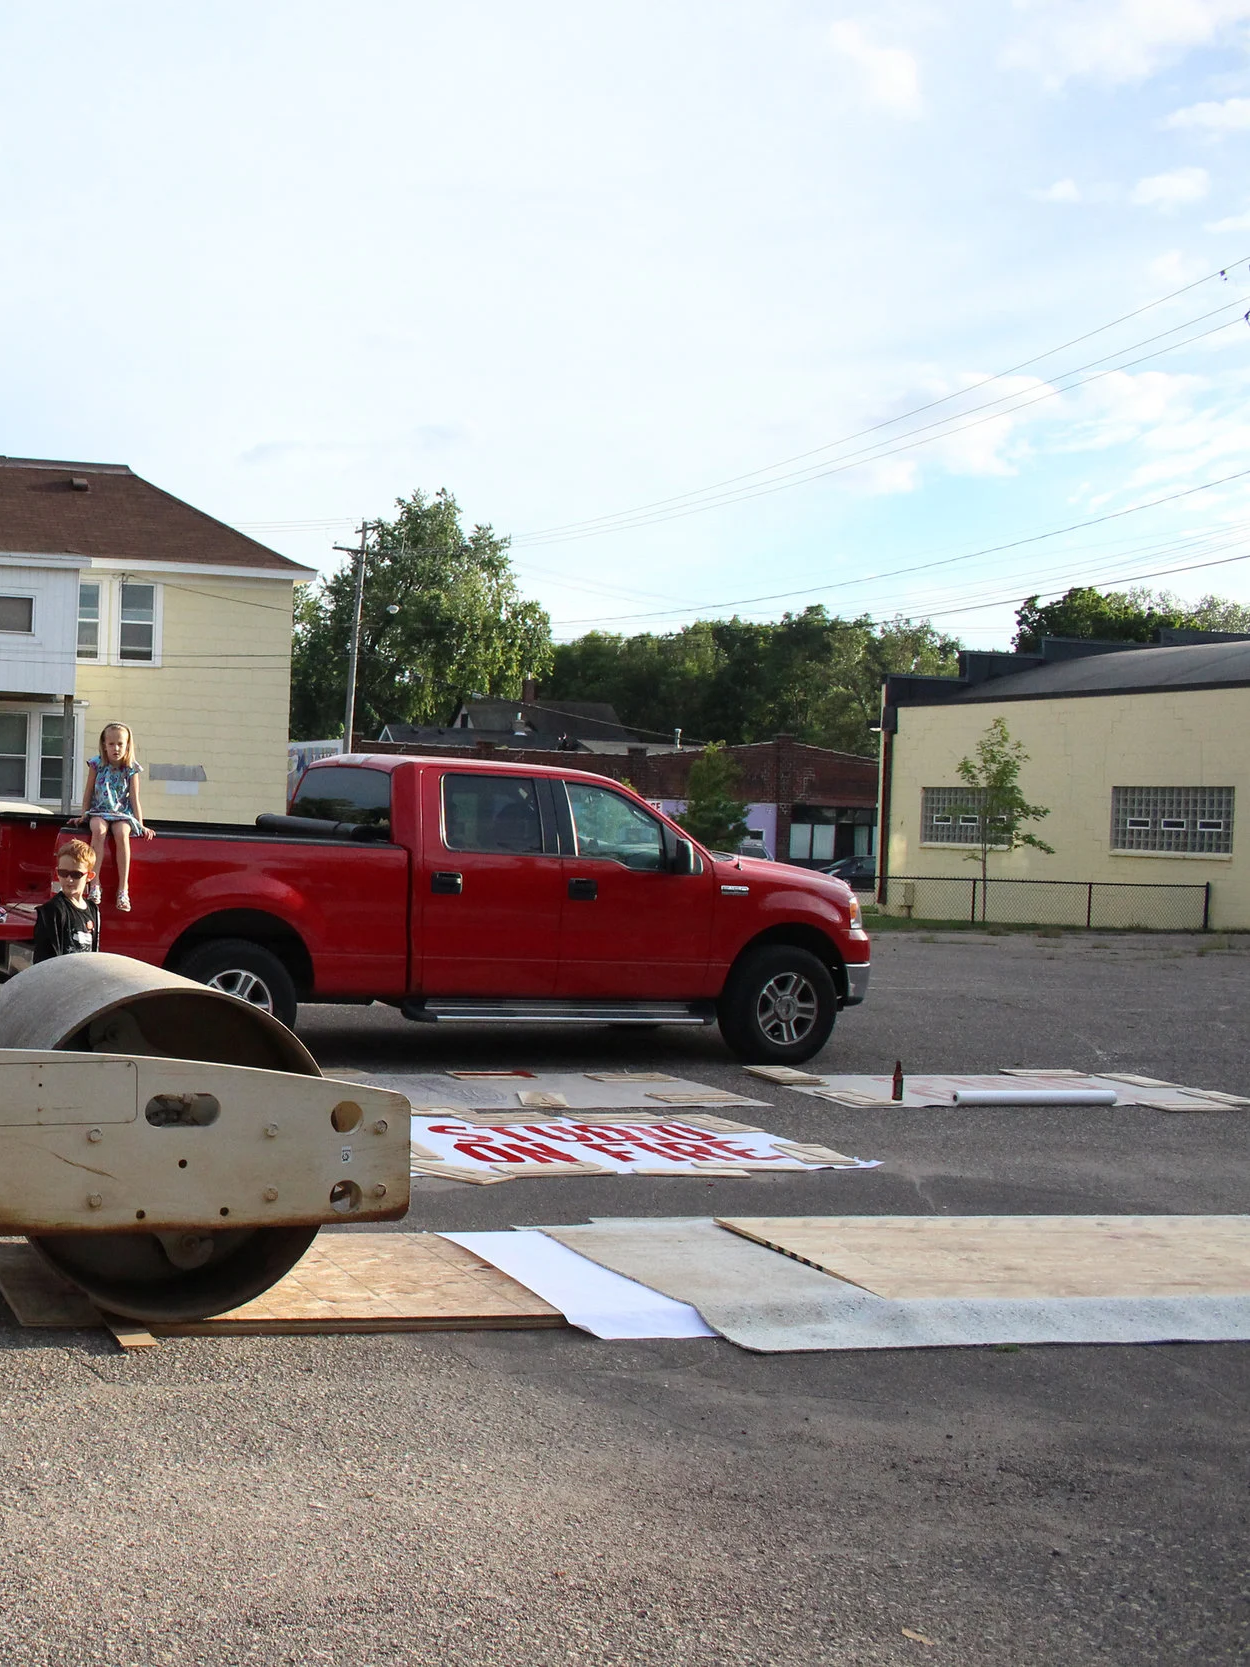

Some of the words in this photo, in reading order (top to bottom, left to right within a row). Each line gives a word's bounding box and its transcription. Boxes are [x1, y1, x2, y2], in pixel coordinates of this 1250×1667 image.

[427, 1124, 717, 1142] STUDIO
[452, 1142, 579, 1163] ON
[582, 1140, 789, 1163] FIRE
